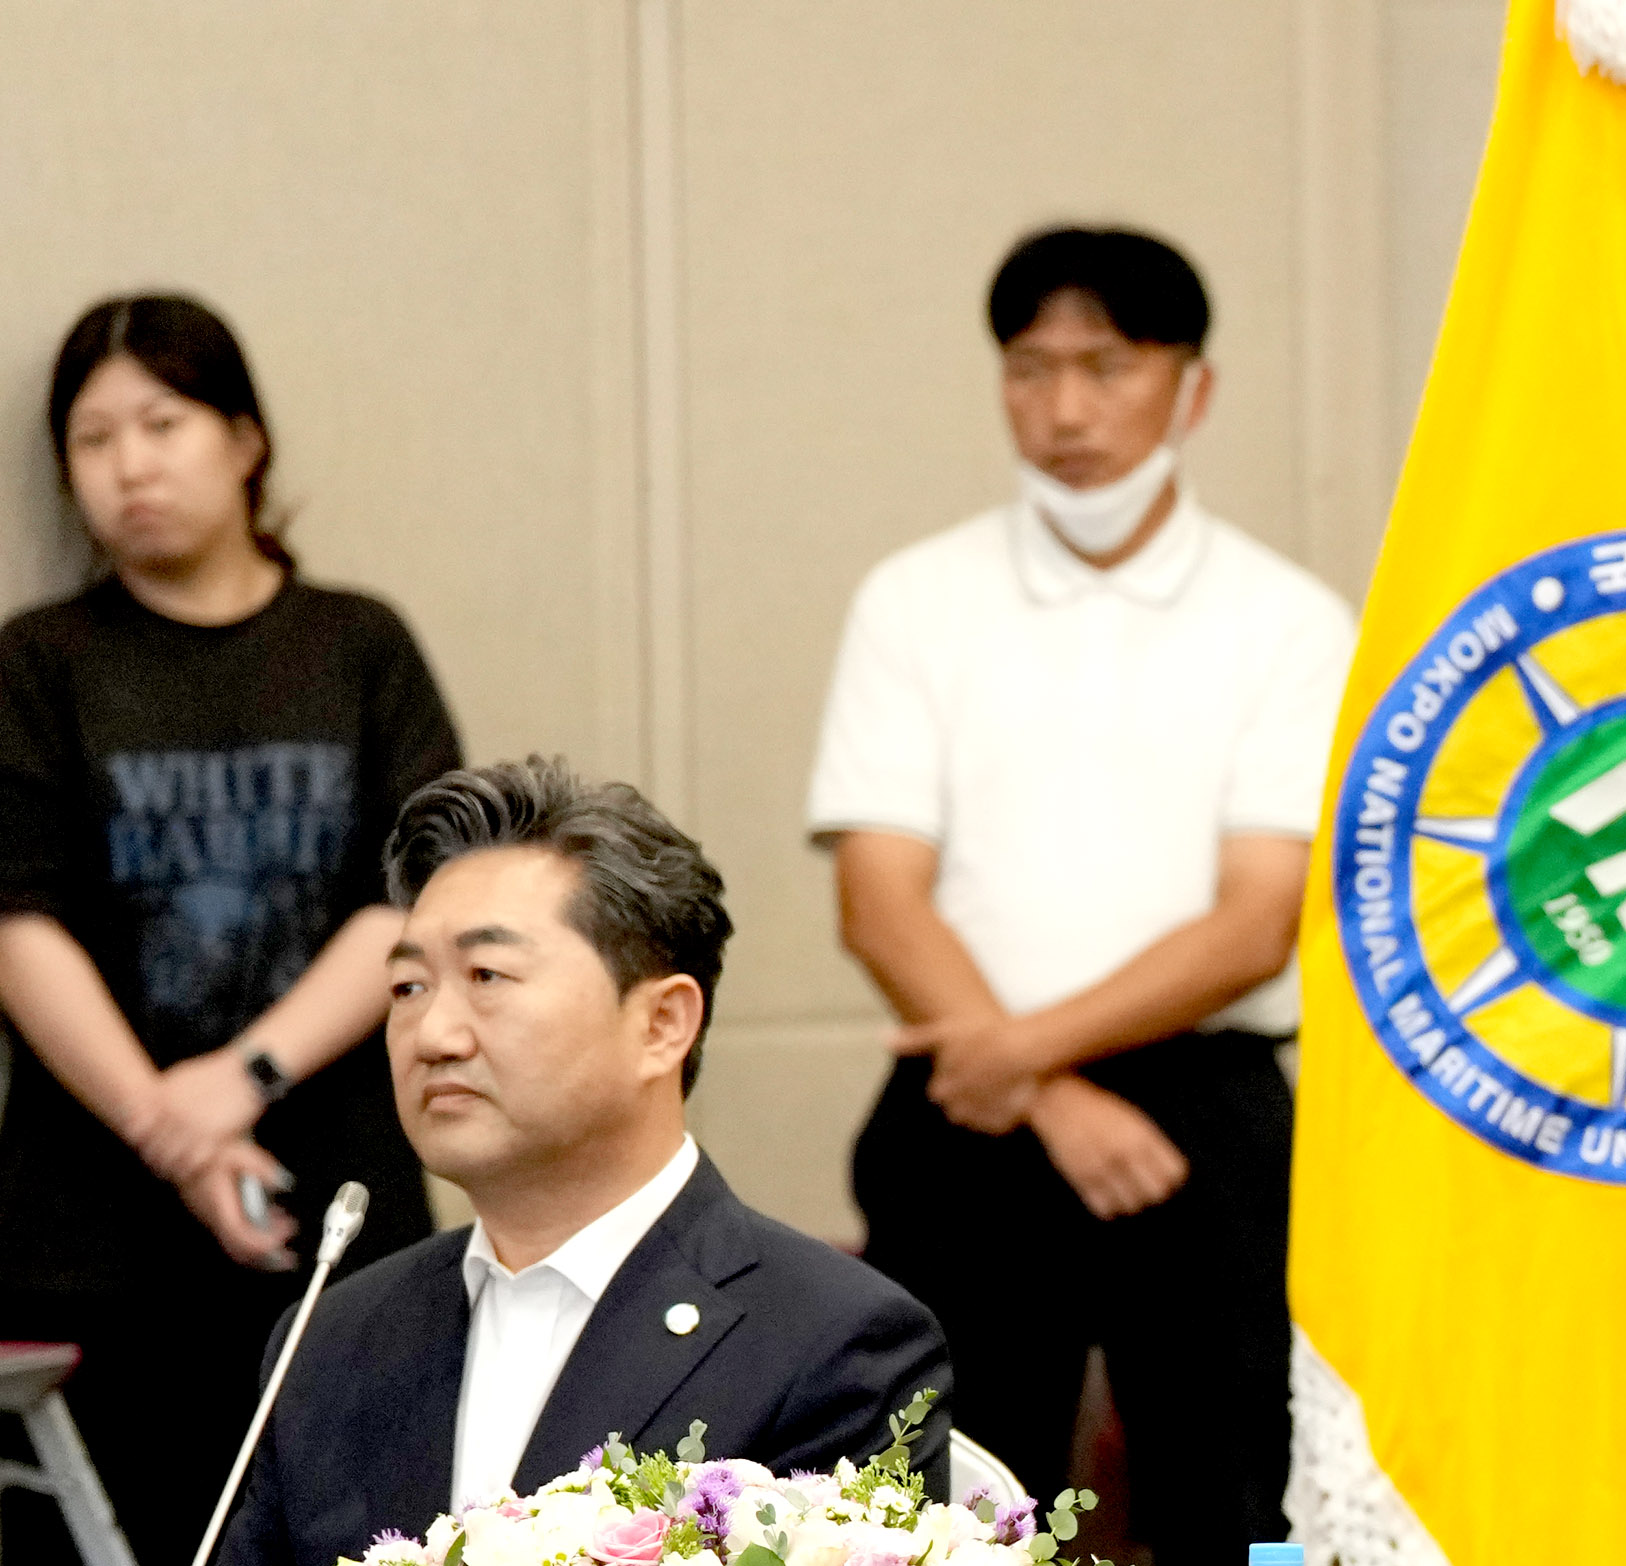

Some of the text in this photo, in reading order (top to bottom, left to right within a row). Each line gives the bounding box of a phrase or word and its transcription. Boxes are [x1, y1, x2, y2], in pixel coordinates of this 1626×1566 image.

[1387, 603, 1519, 752] MOKPO
[1354, 757, 1408, 995] NATIONAL
[1389, 993, 1572, 1152] MARITIME
